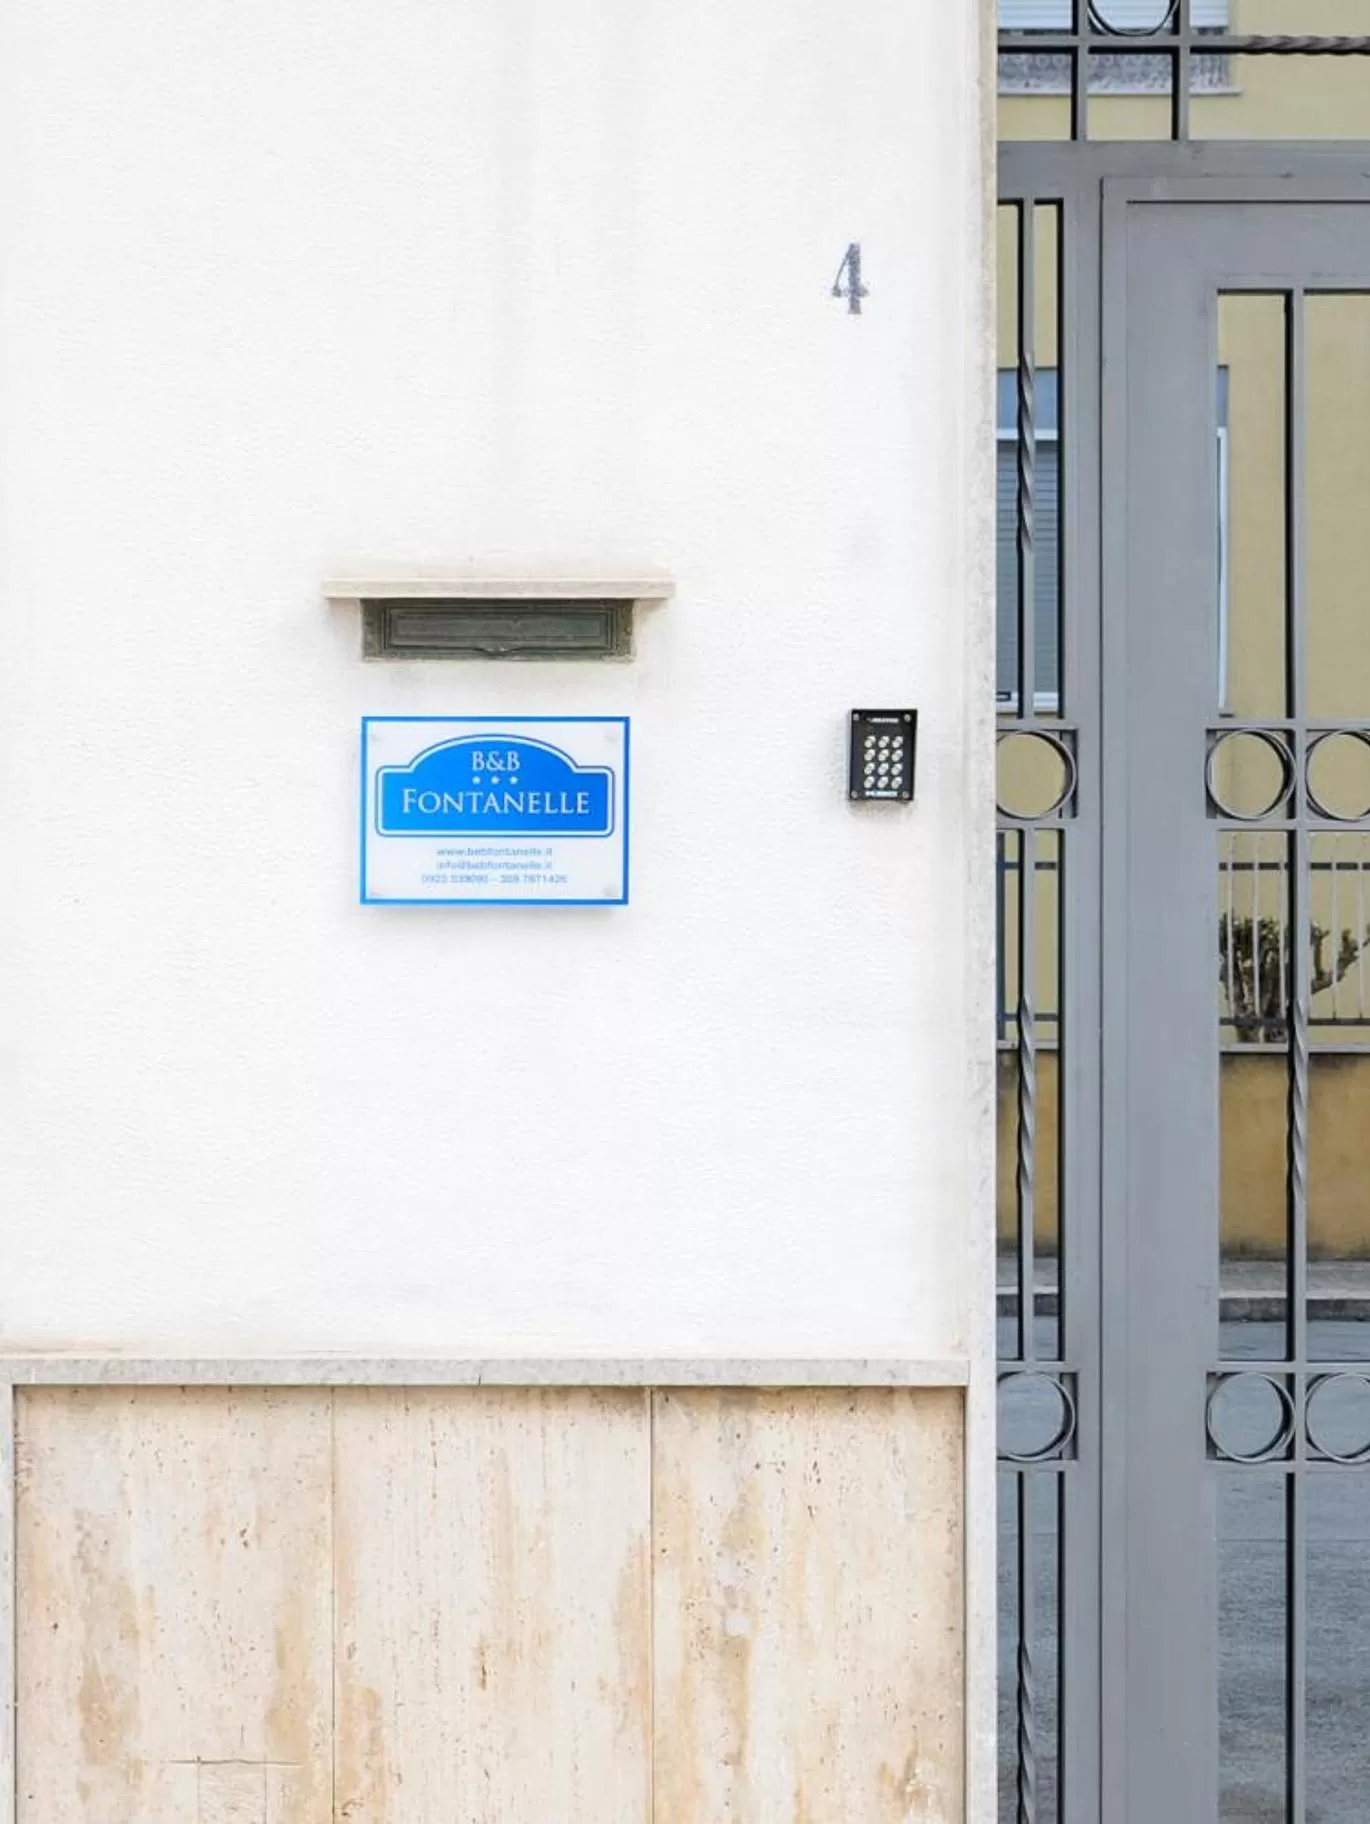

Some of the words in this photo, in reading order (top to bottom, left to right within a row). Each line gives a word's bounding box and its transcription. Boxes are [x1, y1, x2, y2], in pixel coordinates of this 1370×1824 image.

[830, 242, 871, 315] 4
[471, 749, 521, 772] B&B
[401, 787, 590, 815] FONTANELLE
